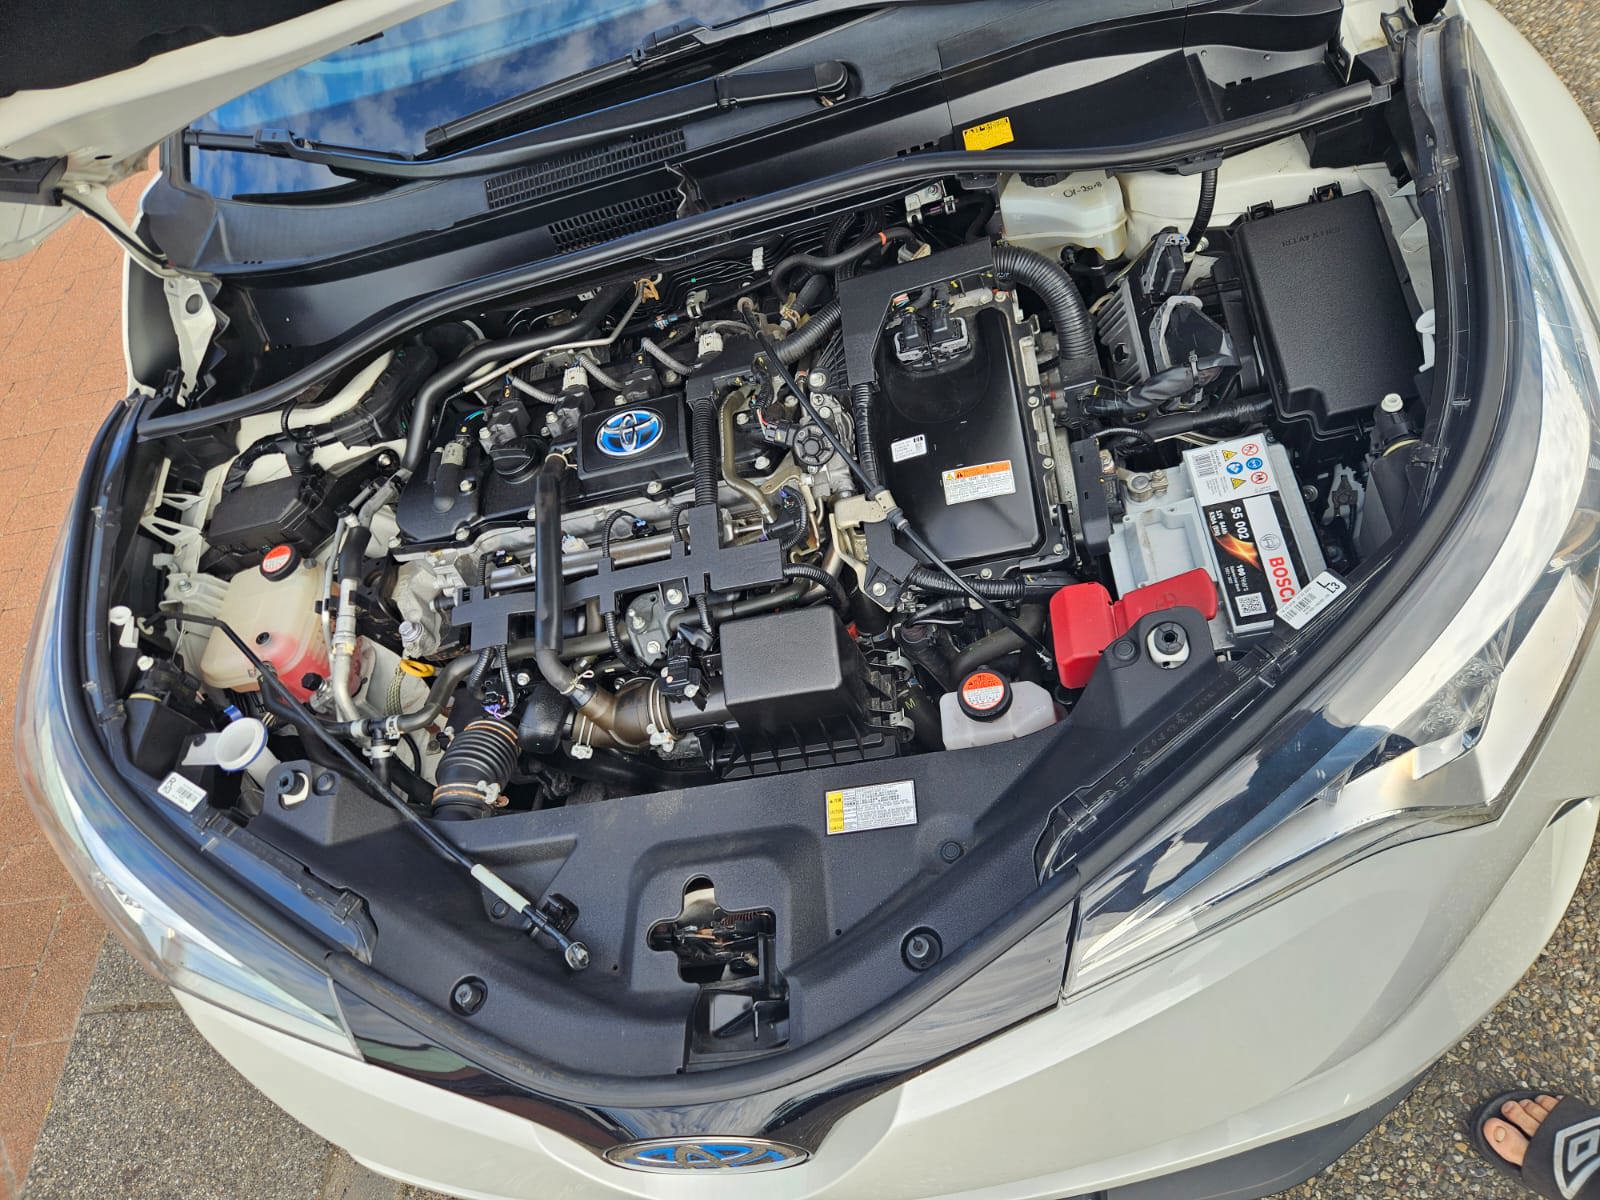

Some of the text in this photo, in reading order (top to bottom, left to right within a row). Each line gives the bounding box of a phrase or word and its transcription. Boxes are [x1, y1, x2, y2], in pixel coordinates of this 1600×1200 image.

[1230, 506, 1250, 540] S5 002
[1316, 580, 1330, 588] L
[1326, 582, 1340, 593] L3
